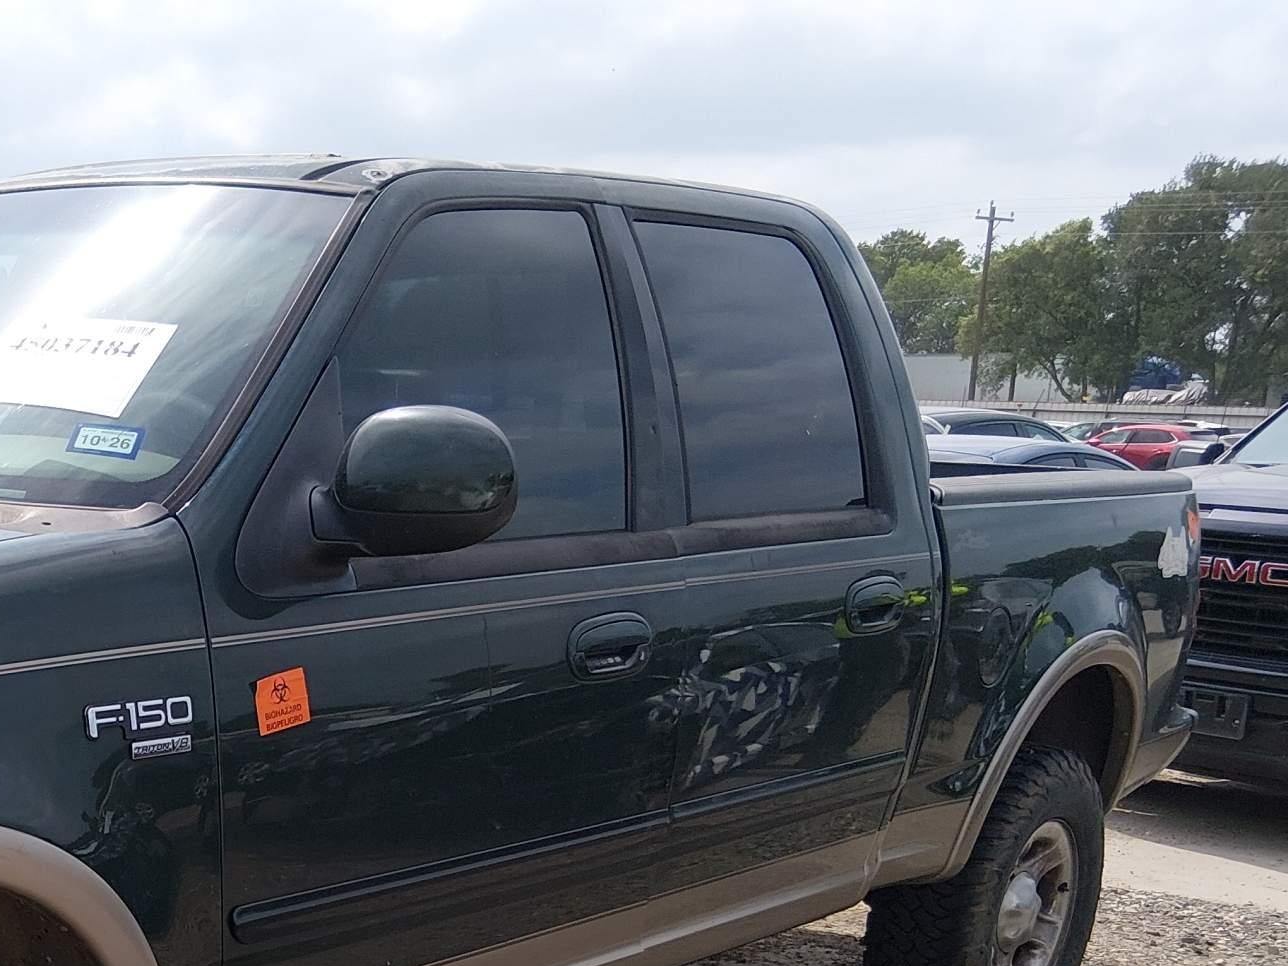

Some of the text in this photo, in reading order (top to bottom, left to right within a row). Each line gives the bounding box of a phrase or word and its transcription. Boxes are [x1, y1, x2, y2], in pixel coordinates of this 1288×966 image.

[81, 434, 132, 450] 10 26
[264, 703, 302, 721] BIOHAZARD
[266, 714, 303, 731] BIOPELIGRO
